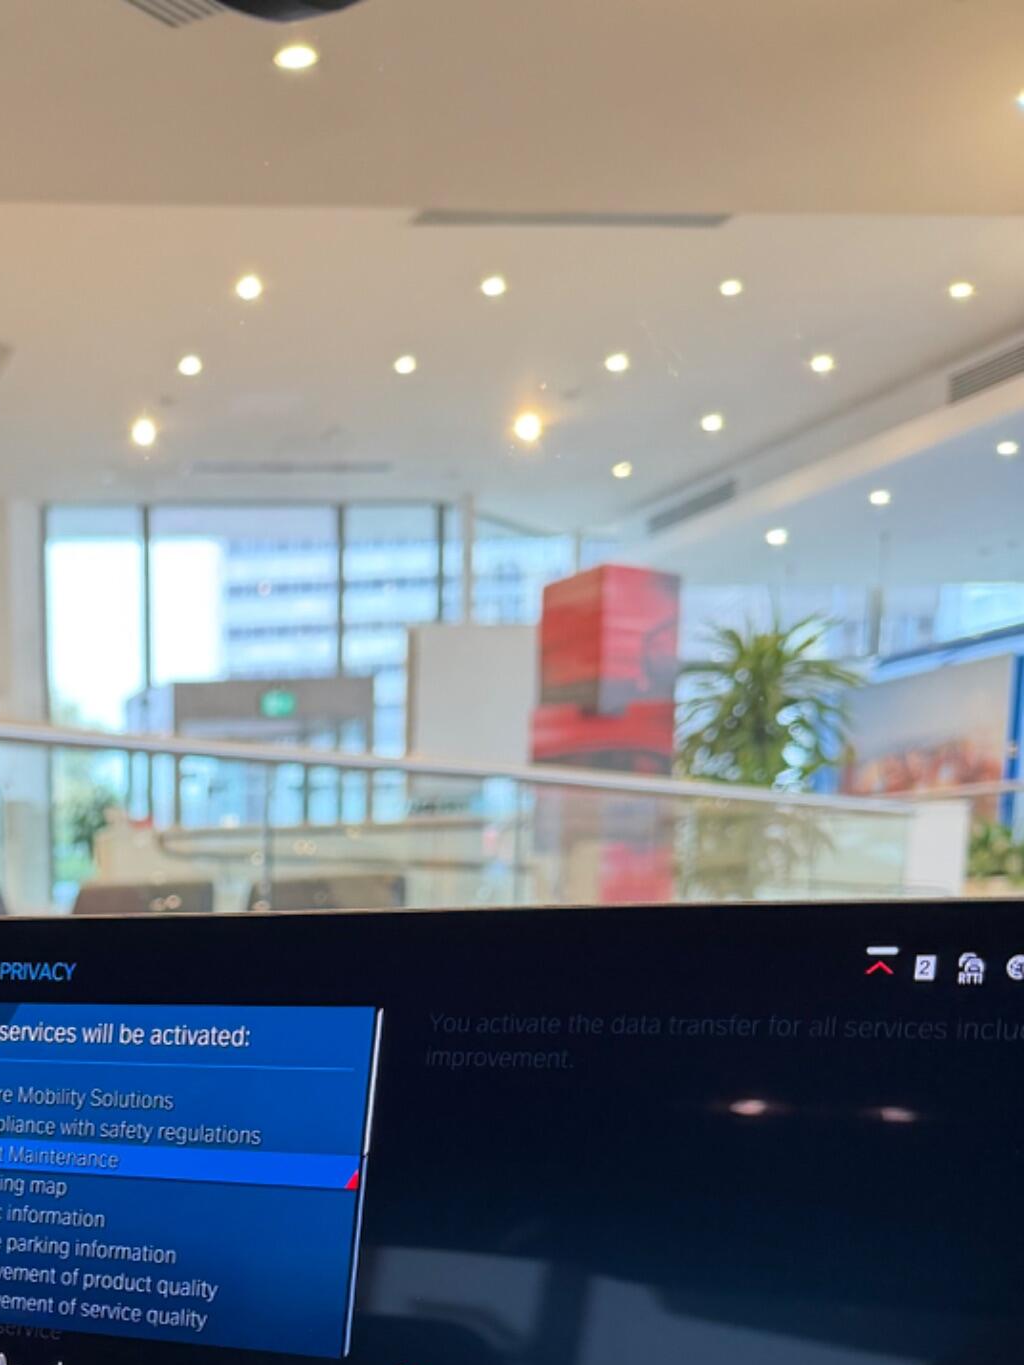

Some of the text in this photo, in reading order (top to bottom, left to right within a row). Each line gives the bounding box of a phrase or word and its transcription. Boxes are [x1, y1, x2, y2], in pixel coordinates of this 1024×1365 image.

[0, 961, 77, 982] PRIVACY
[81, 1023, 114, 1044] will
[118, 1024, 145, 1046] be
[150, 1025, 251, 1048] activated:
[428, 1012, 472, 1036] You
[476, 1013, 561, 1036] activate
[568, 1014, 605, 1036] the
[611, 1014, 662, 1037] data
[668, 1014, 761, 1038] transfer
[769, 1015, 803, 1038] for
[808, 1015, 838, 1038] all
[844, 1018, 948, 1041] services
[425, 1047, 575, 1071] improvement.
[18, 1088, 86, 1110] Mobility
[90, 1090, 175, 1110] Solutions
[60, 1119, 95, 1138] with
[100, 1120, 154, 1144] safety
[158, 1124, 263, 1146] regulations
[8, 1147, 120, 1169] Maintenance
[29, 1180, 68, 1199] map
[7, 1206, 106, 1228] information
[7, 1237, 70, 1259] parking
[75, 1240, 177, 1264] information
[61, 1268, 79, 1287] of
[82, 1269, 153, 1297] product
[157, 1278, 219, 1301] quality
[58, 1298, 76, 1317] of
[80, 1302, 142, 1323] service
[146, 1308, 208, 1331] quality
